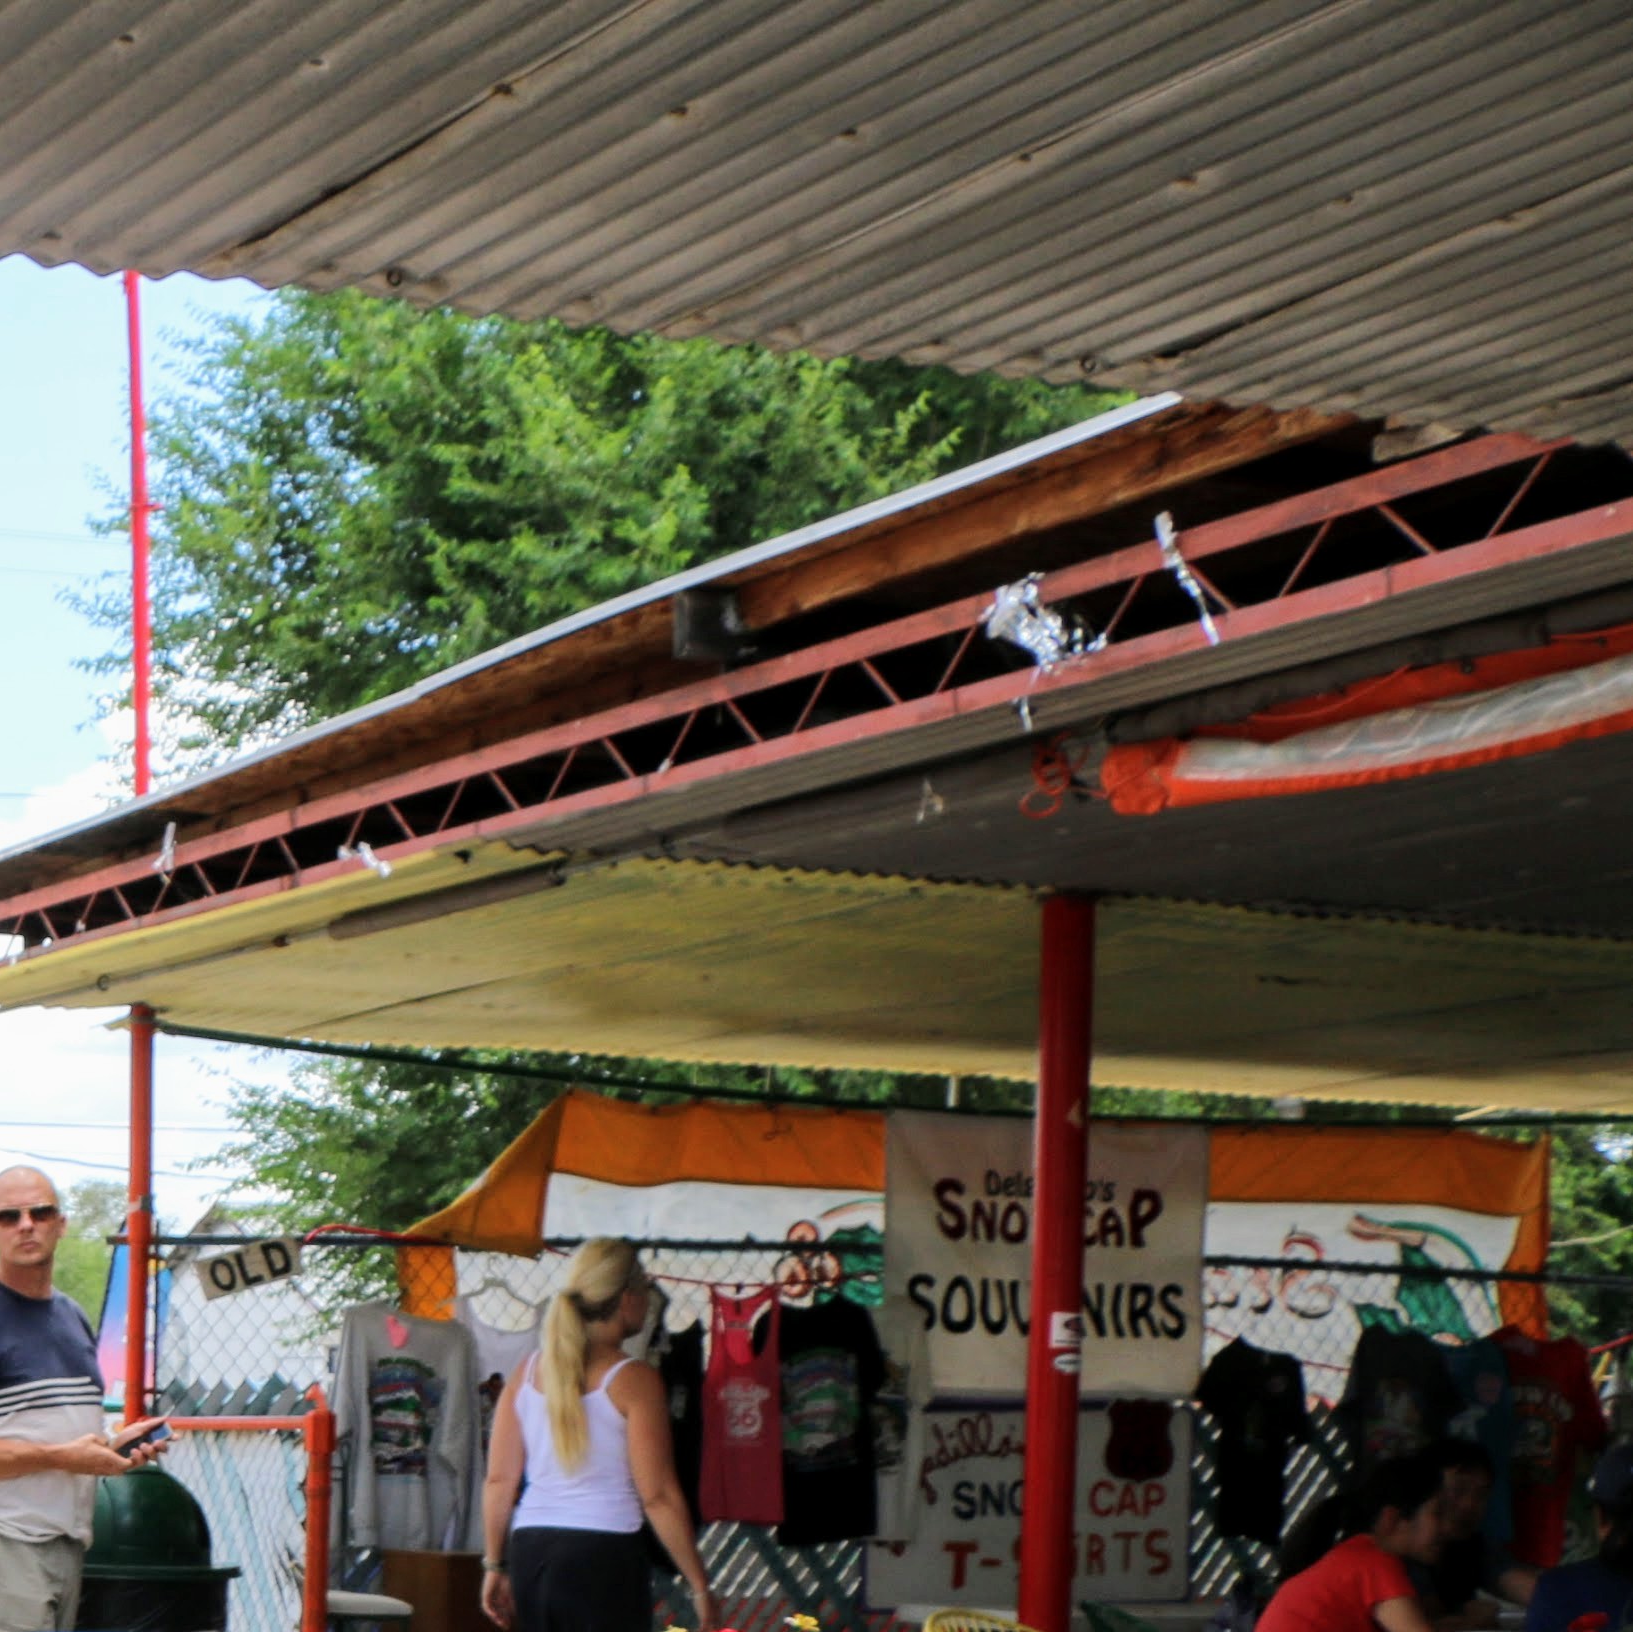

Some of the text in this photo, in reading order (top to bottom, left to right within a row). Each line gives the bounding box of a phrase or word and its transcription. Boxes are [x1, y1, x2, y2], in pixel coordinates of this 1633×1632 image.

[933, 1177, 1030, 1244] SNO
[209, 1240, 292, 1292] OLD
[907, 1272, 1188, 1340] SOUVNIRS
[1088, 1479, 1169, 1519] CAP
